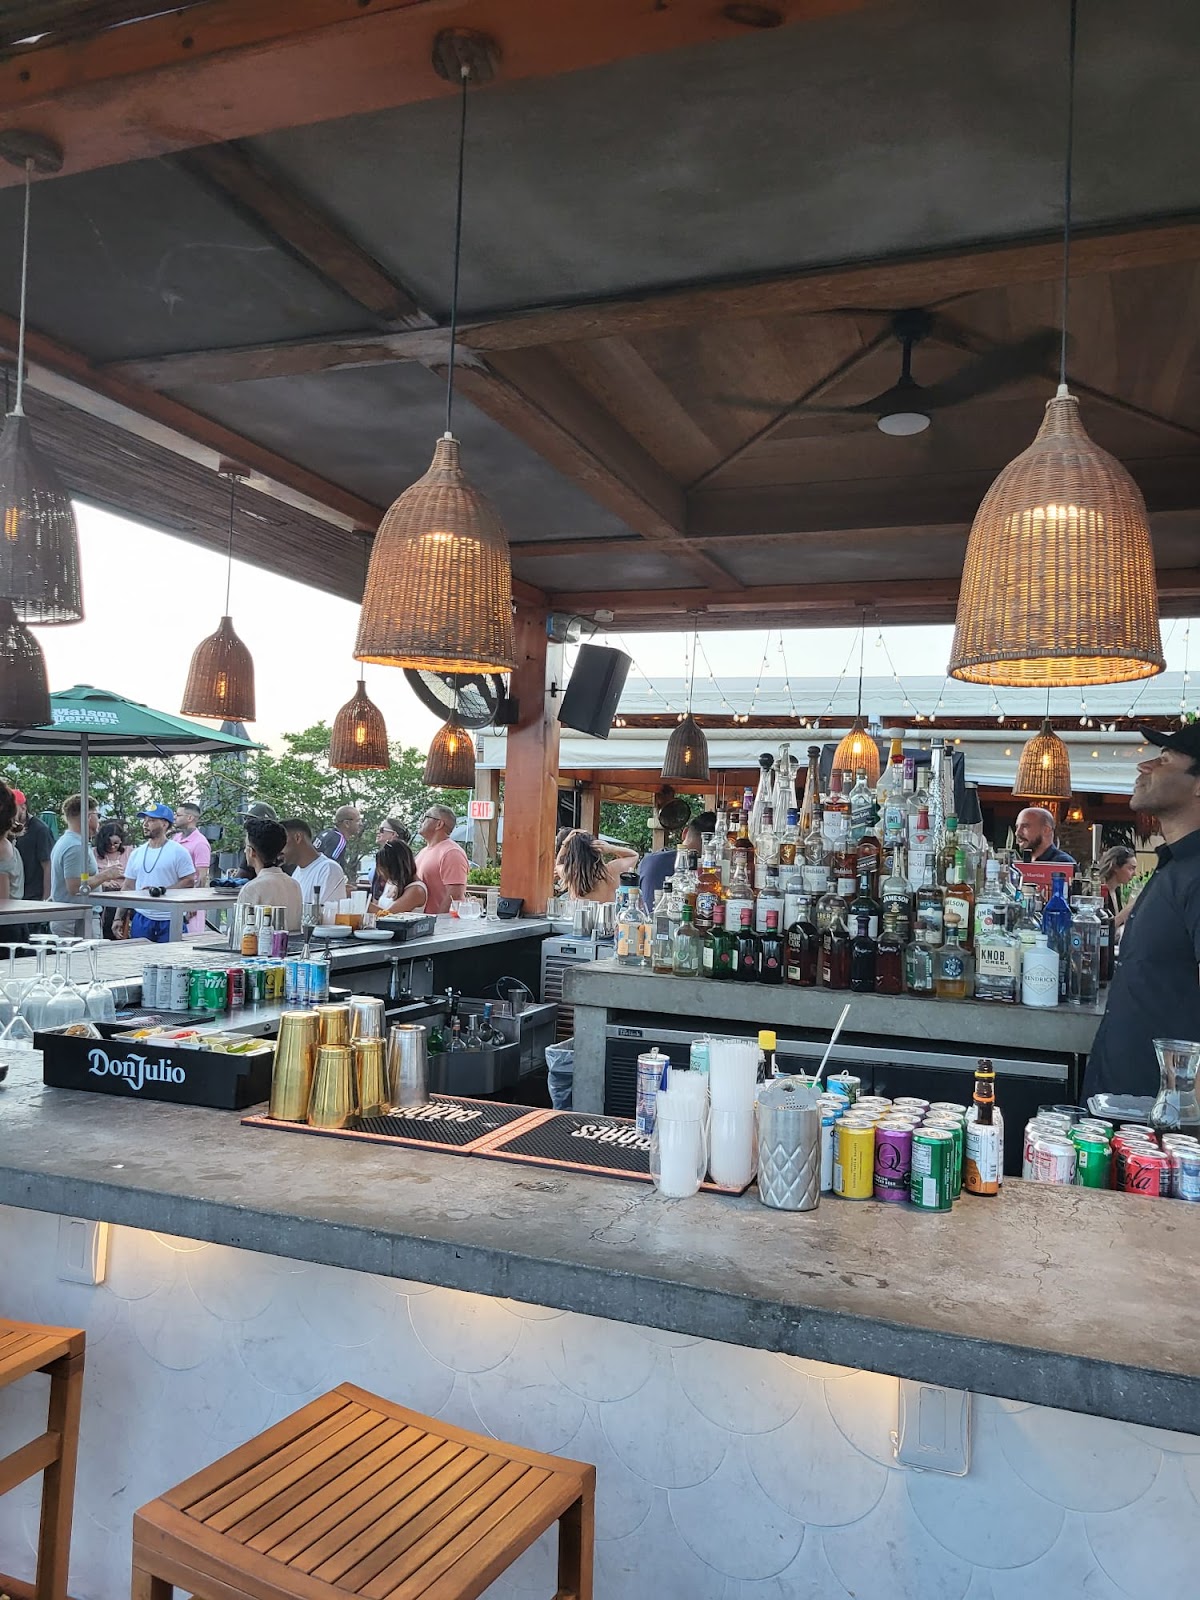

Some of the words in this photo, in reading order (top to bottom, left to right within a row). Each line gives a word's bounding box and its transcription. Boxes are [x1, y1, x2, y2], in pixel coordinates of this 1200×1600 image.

[52, 708, 118, 719] Maison
[471, 802, 490, 817] EXIT
[882, 895, 909, 904] JAMESON
[981, 949, 1005, 961] KNOB
[877, 1142, 902, 1172] Q
[1126, 1161, 1154, 1190] ola
